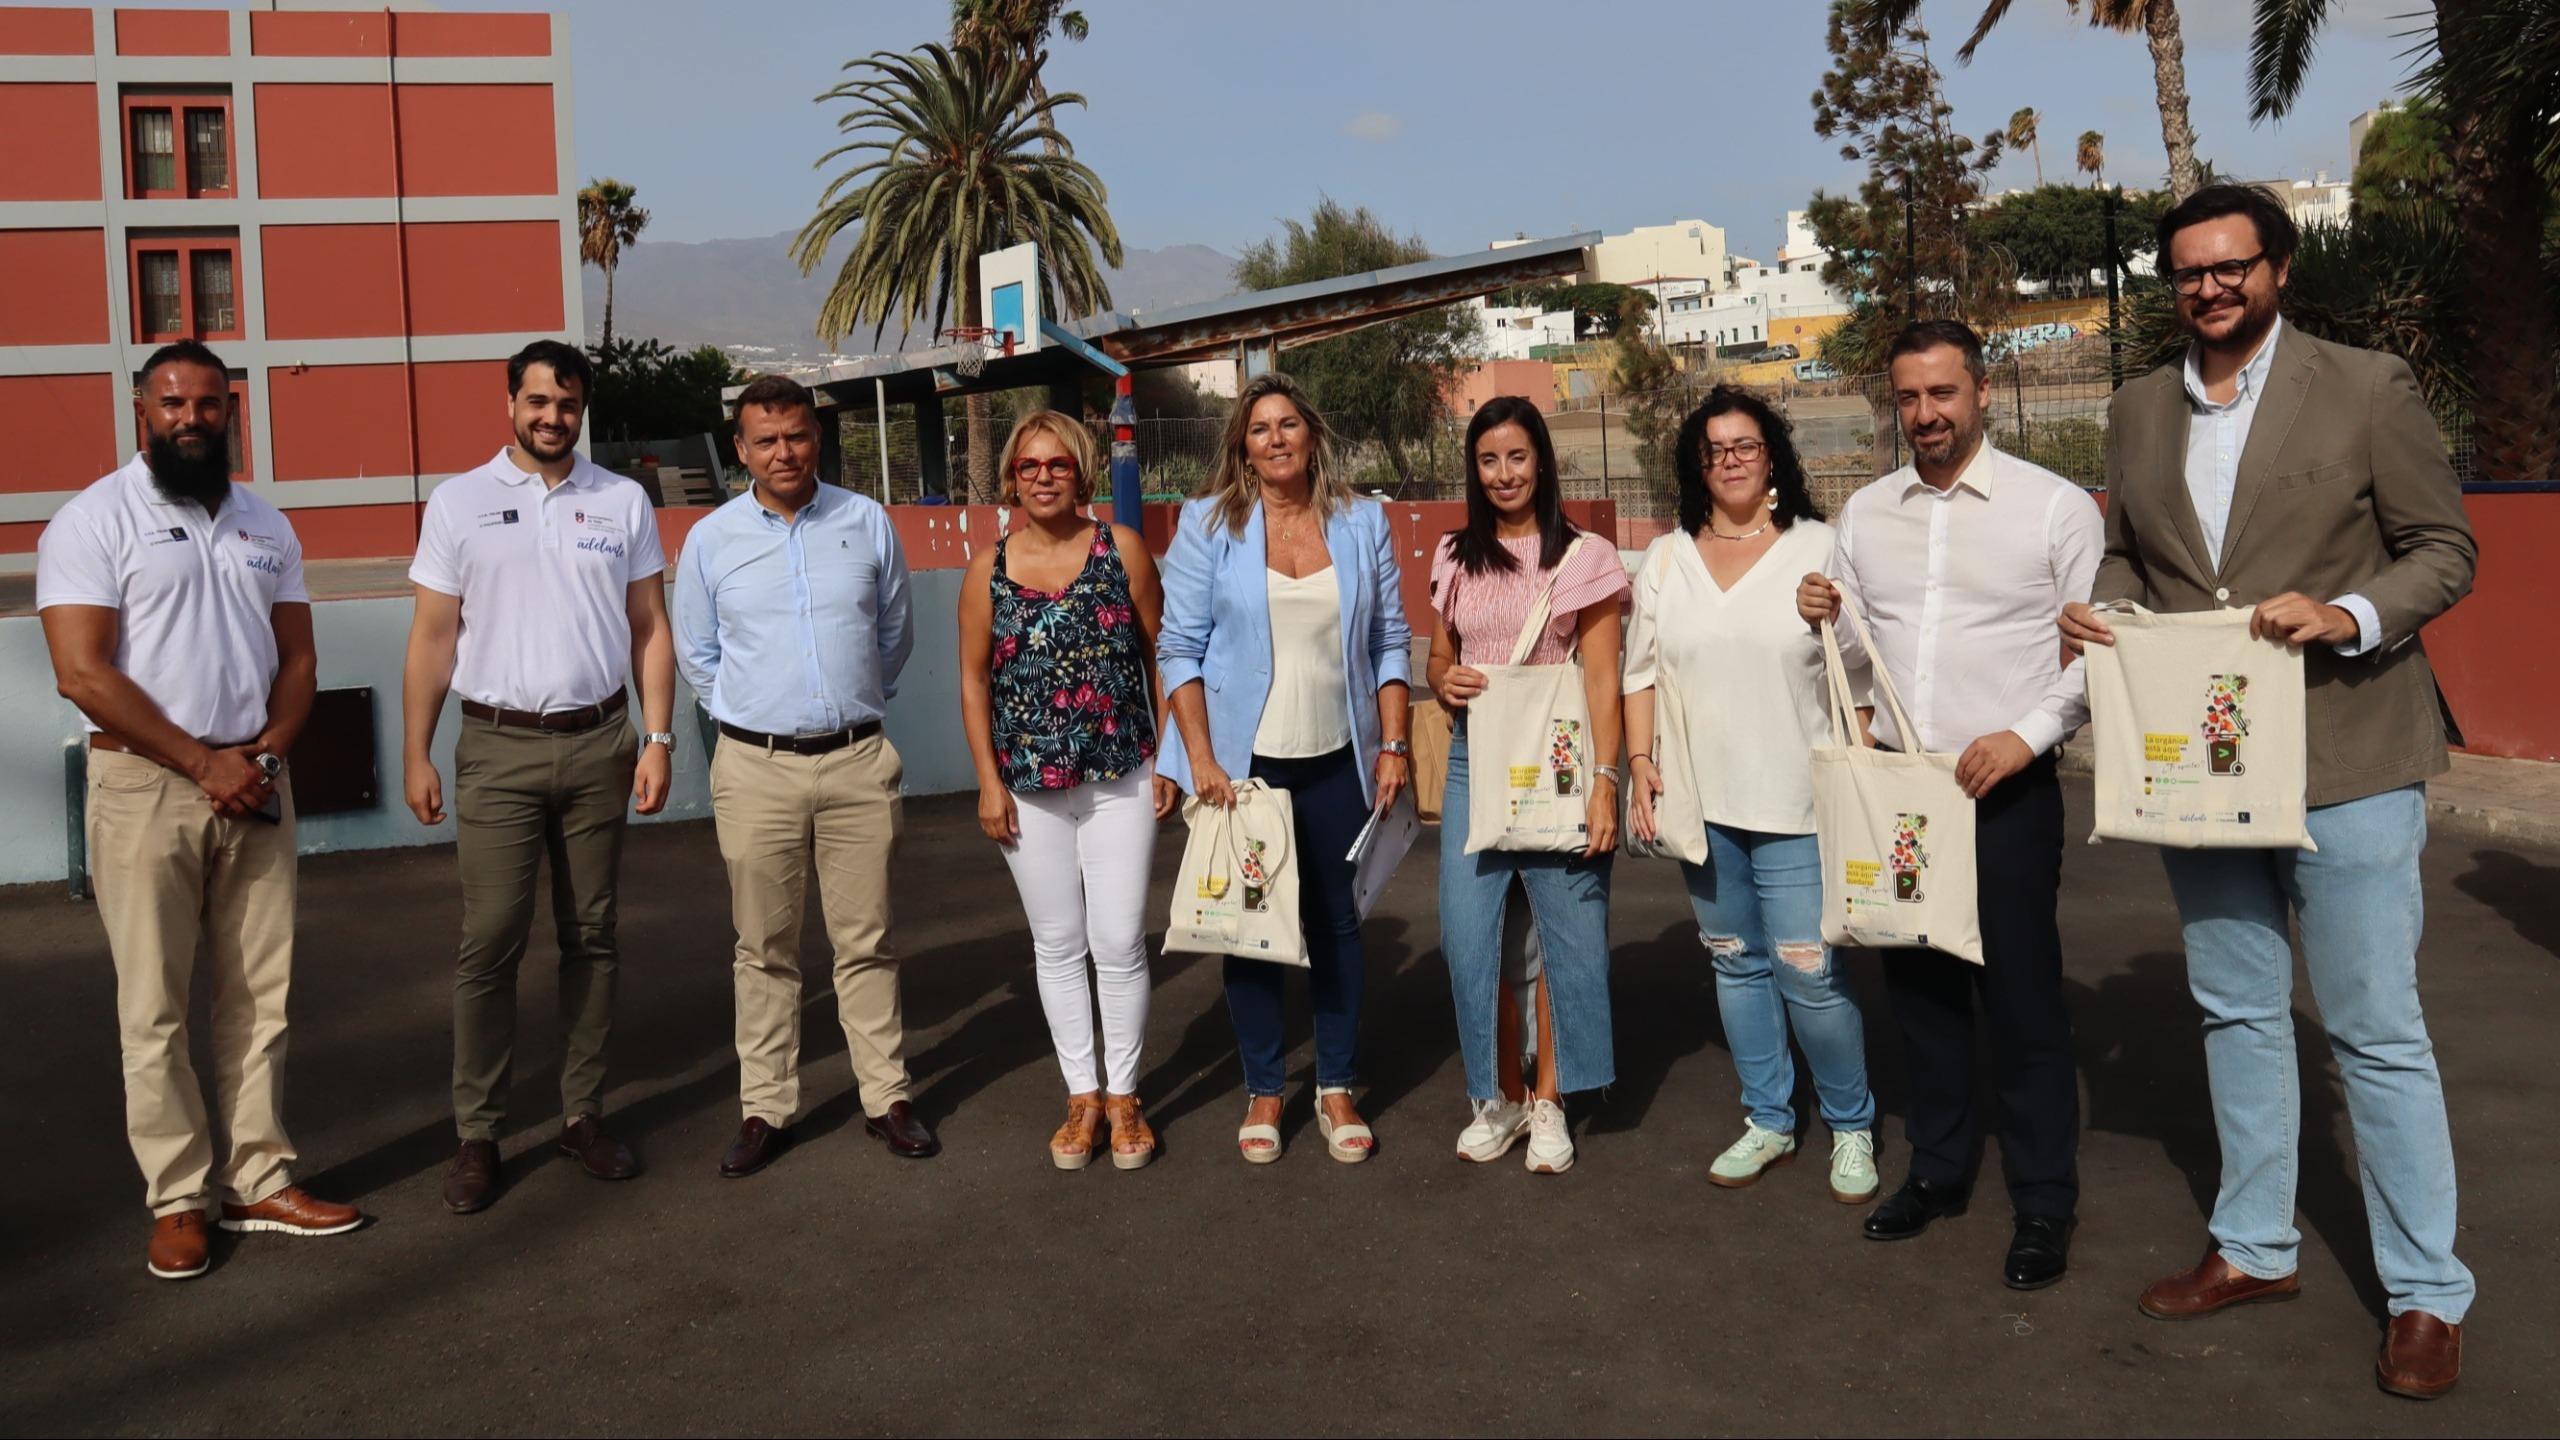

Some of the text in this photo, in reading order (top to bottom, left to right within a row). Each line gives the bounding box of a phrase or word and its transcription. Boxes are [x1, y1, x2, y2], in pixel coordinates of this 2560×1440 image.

[577, 536, 624, 558] adelante
[2145, 735, 2188, 745] La orgánica
[2145, 753, 2181, 762] quedarse
